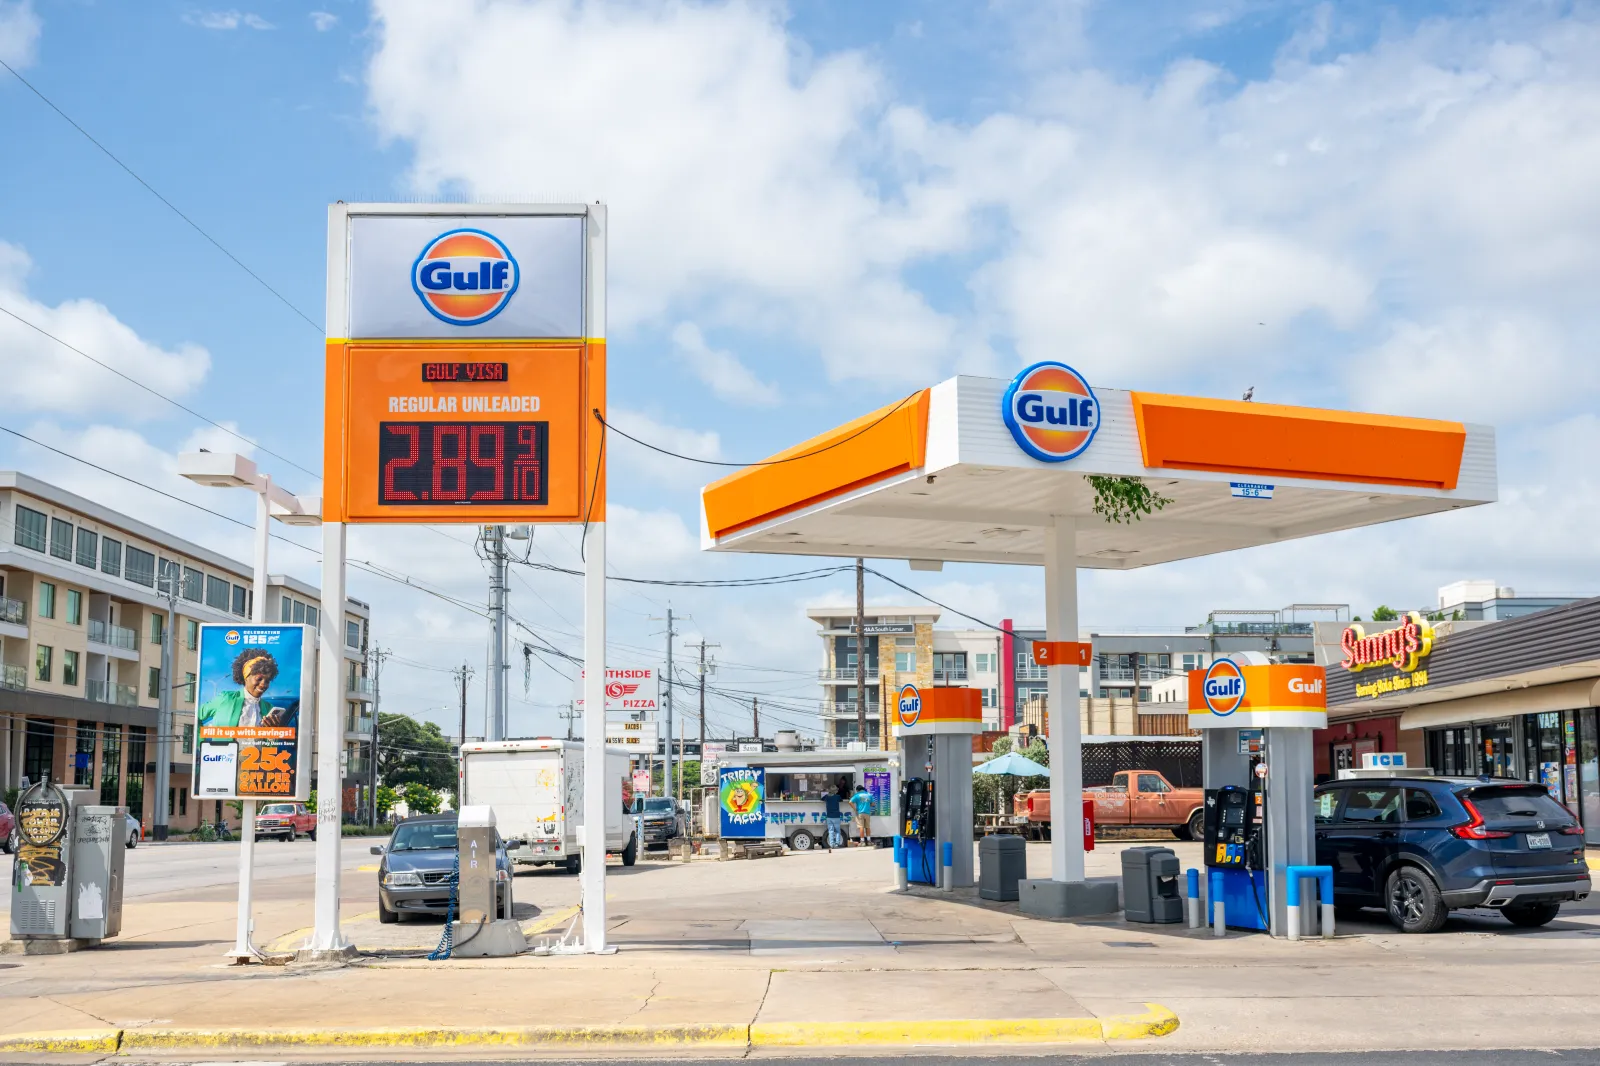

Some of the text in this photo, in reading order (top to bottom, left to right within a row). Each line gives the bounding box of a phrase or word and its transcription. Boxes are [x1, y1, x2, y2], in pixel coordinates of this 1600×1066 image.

[420, 261, 509, 290] Gulf
[426, 364, 503, 380] GULF VISA
[389, 396, 541, 413] REGULAR UNLEADED
[1017, 394, 1093, 427] Gulf
[384, 425, 505, 500] 2.89
[243, 635, 267, 644] 125
[1341, 614, 1420, 668] Sunny's
[1039, 648, 1048, 659] 2
[1079, 649, 1086, 660] 1
[582, 670, 651, 678] THSIDE
[1206, 678, 1241, 696] Gulf
[1288, 677, 1323, 695] Gulf
[1393, 675, 1411, 690] Since
[623, 700, 656, 708] PIZZA
[900, 698, 919, 712] Gulf
[1539, 712, 1559, 728] VAPE
[203, 728, 216, 736] Fill
[224, 730, 233, 738] up
[236, 729, 257, 737] with
[257, 729, 292, 738] savings!
[1372, 754, 1404, 766] ICE
[240, 772, 291, 783] OFF PER
[721, 769, 763, 784] TRIPPY
[239, 782, 290, 793] GALLON
[728, 811, 763, 825] TACOS
[764, 811, 853, 825] TRIPPY TAOS
[470, 840, 478, 869] AIR
